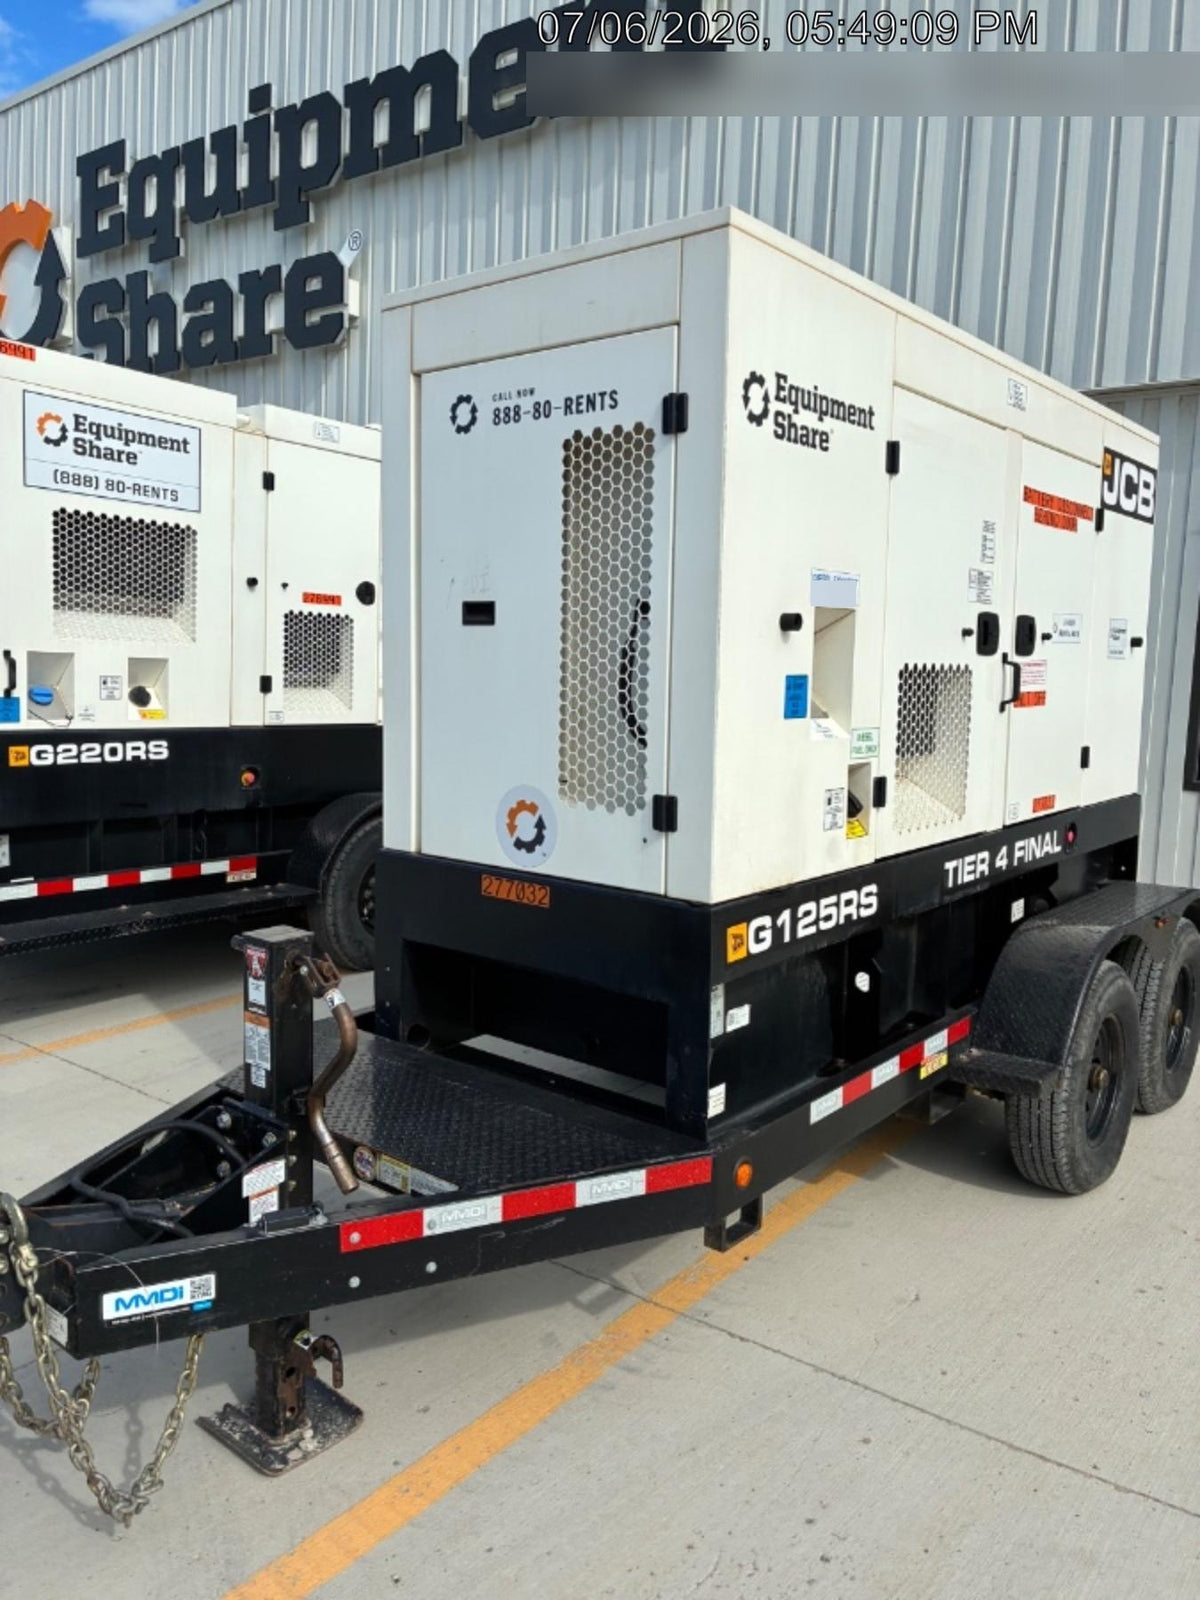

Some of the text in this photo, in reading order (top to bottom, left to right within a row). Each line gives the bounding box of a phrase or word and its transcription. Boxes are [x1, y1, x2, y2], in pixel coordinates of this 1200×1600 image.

[76, 251, 345, 373] Share
[492, 387, 536, 402] CALL NOW
[492, 389, 619, 426] 888-80-RENTS
[774, 371, 875, 431] Equipment
[73, 413, 191, 454] Equipment
[773, 410, 830, 452] Share
[73, 437, 138, 465] Share
[53, 469, 179, 502] (888) 80-RENTS
[1103, 457, 1155, 518] JCB
[29, 740, 169, 767] G220RS
[943, 829, 1062, 888] TIER 4 FINAL
[482, 875, 549, 906] 277032
[748, 883, 879, 955] G125RS
[115, 1285, 184, 1313] MMDI
